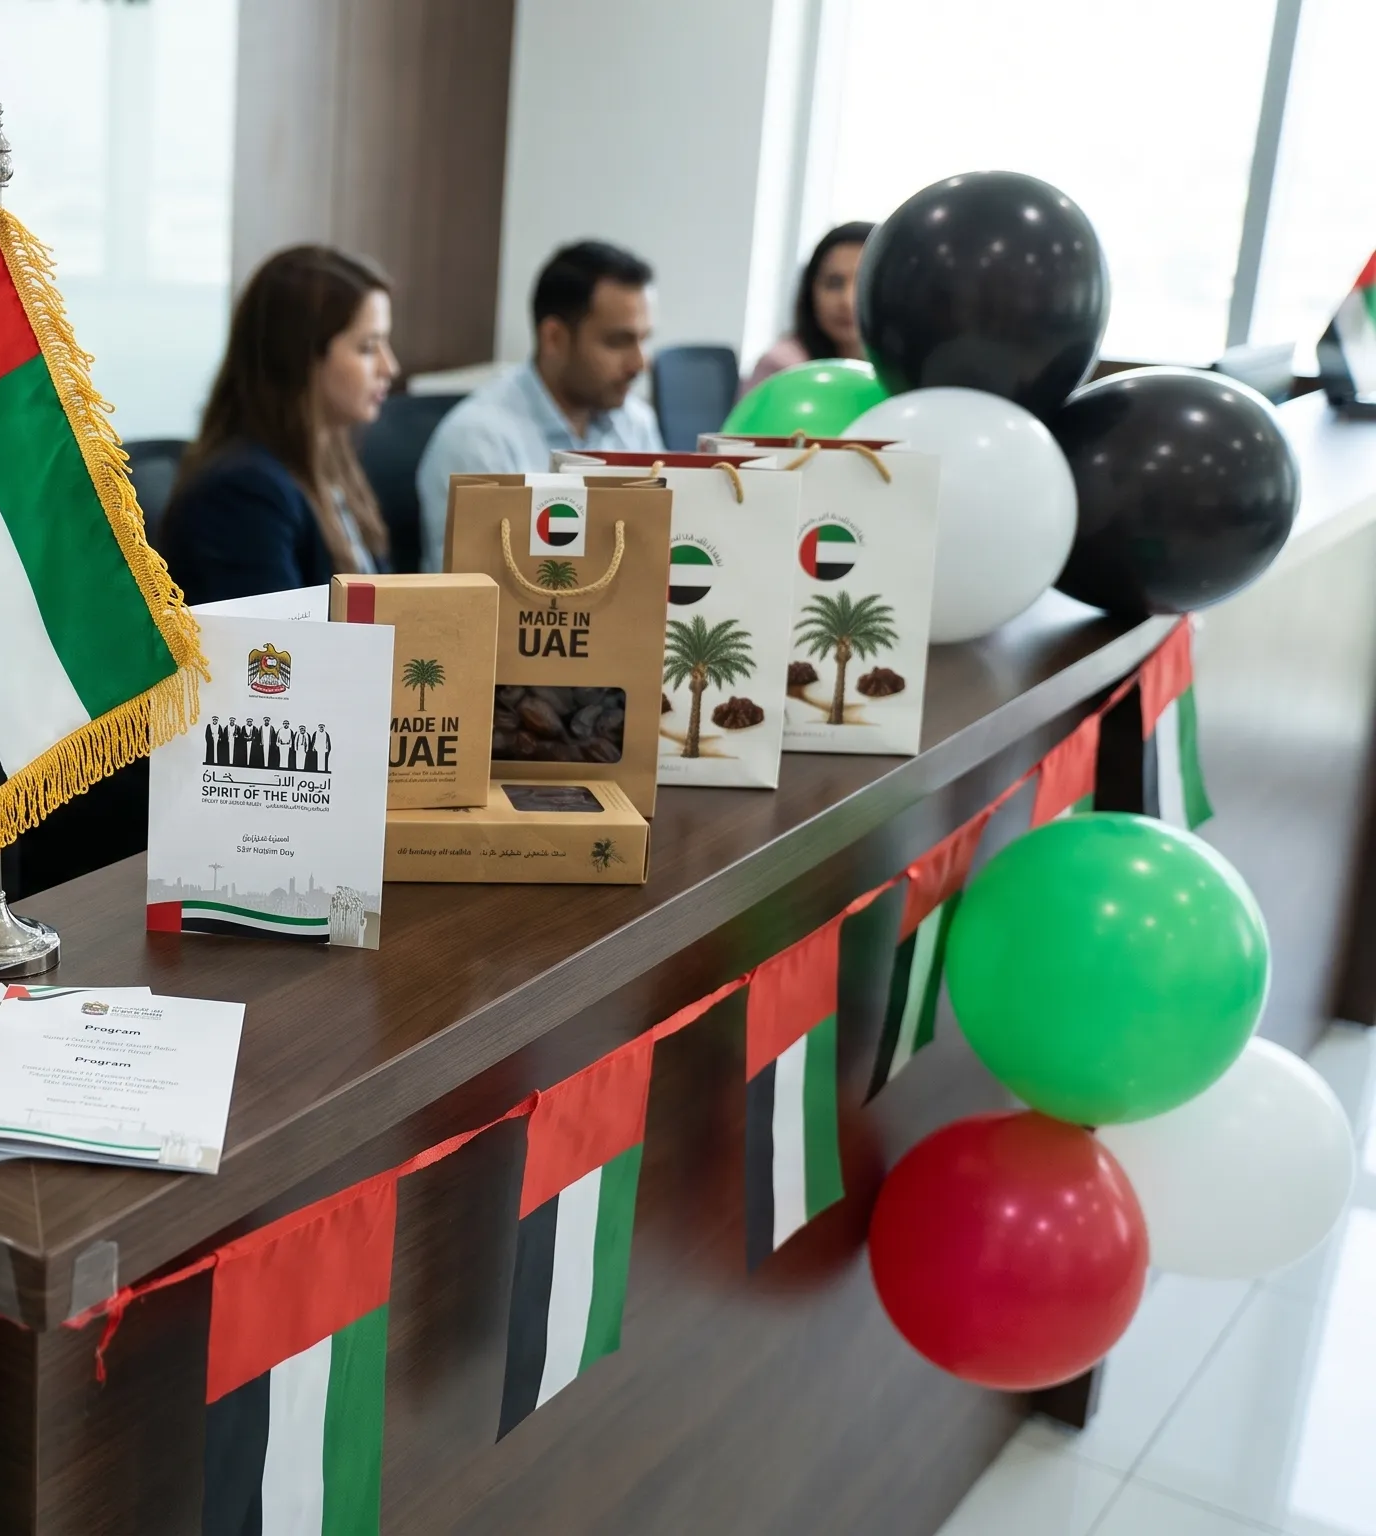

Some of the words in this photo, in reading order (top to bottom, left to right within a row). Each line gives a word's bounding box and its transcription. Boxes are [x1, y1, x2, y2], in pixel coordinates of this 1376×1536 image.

[519, 611, 568, 626] MADE
[573, 612, 590, 626] IN
[518, 628, 589, 657] UAE
[442, 717, 459, 732] IN
[388, 736, 458, 767] UAE
[202, 785, 240, 798] SPIRIT
[244, 789, 260, 799] OF
[263, 790, 288, 802] THE
[292, 792, 330, 804] UNION
[84, 1024, 141, 1036] Program
[74, 1056, 131, 1068] Program
